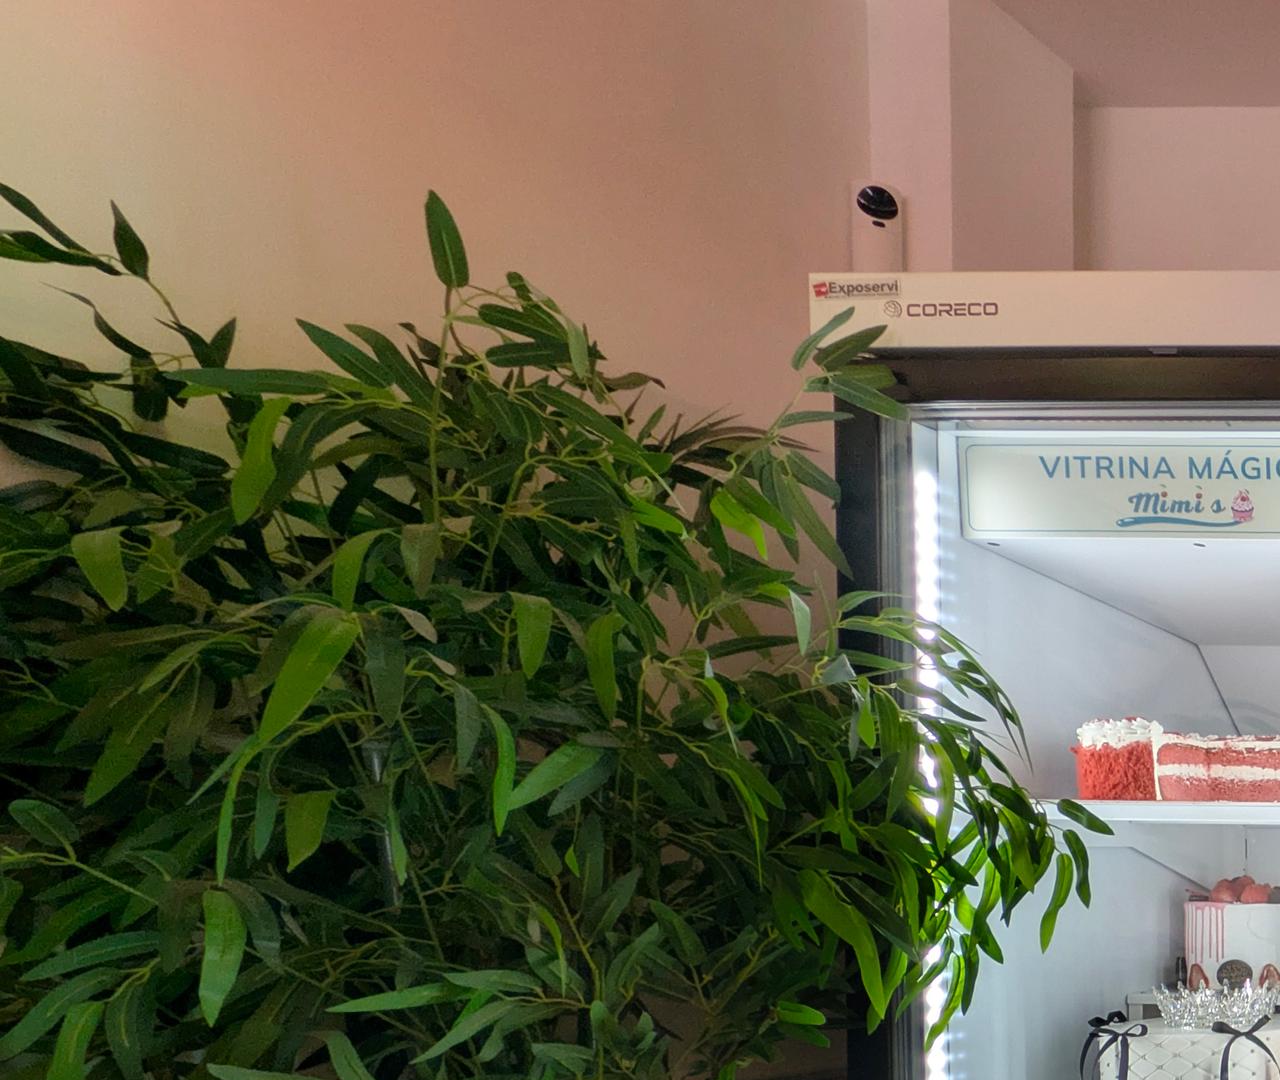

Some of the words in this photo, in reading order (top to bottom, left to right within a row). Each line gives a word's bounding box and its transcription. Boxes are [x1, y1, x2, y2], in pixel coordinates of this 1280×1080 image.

[828, 280, 899, 296] Exposervi
[906, 302, 999, 317] CORECO
[1038, 455, 1176, 479] VITRINA
